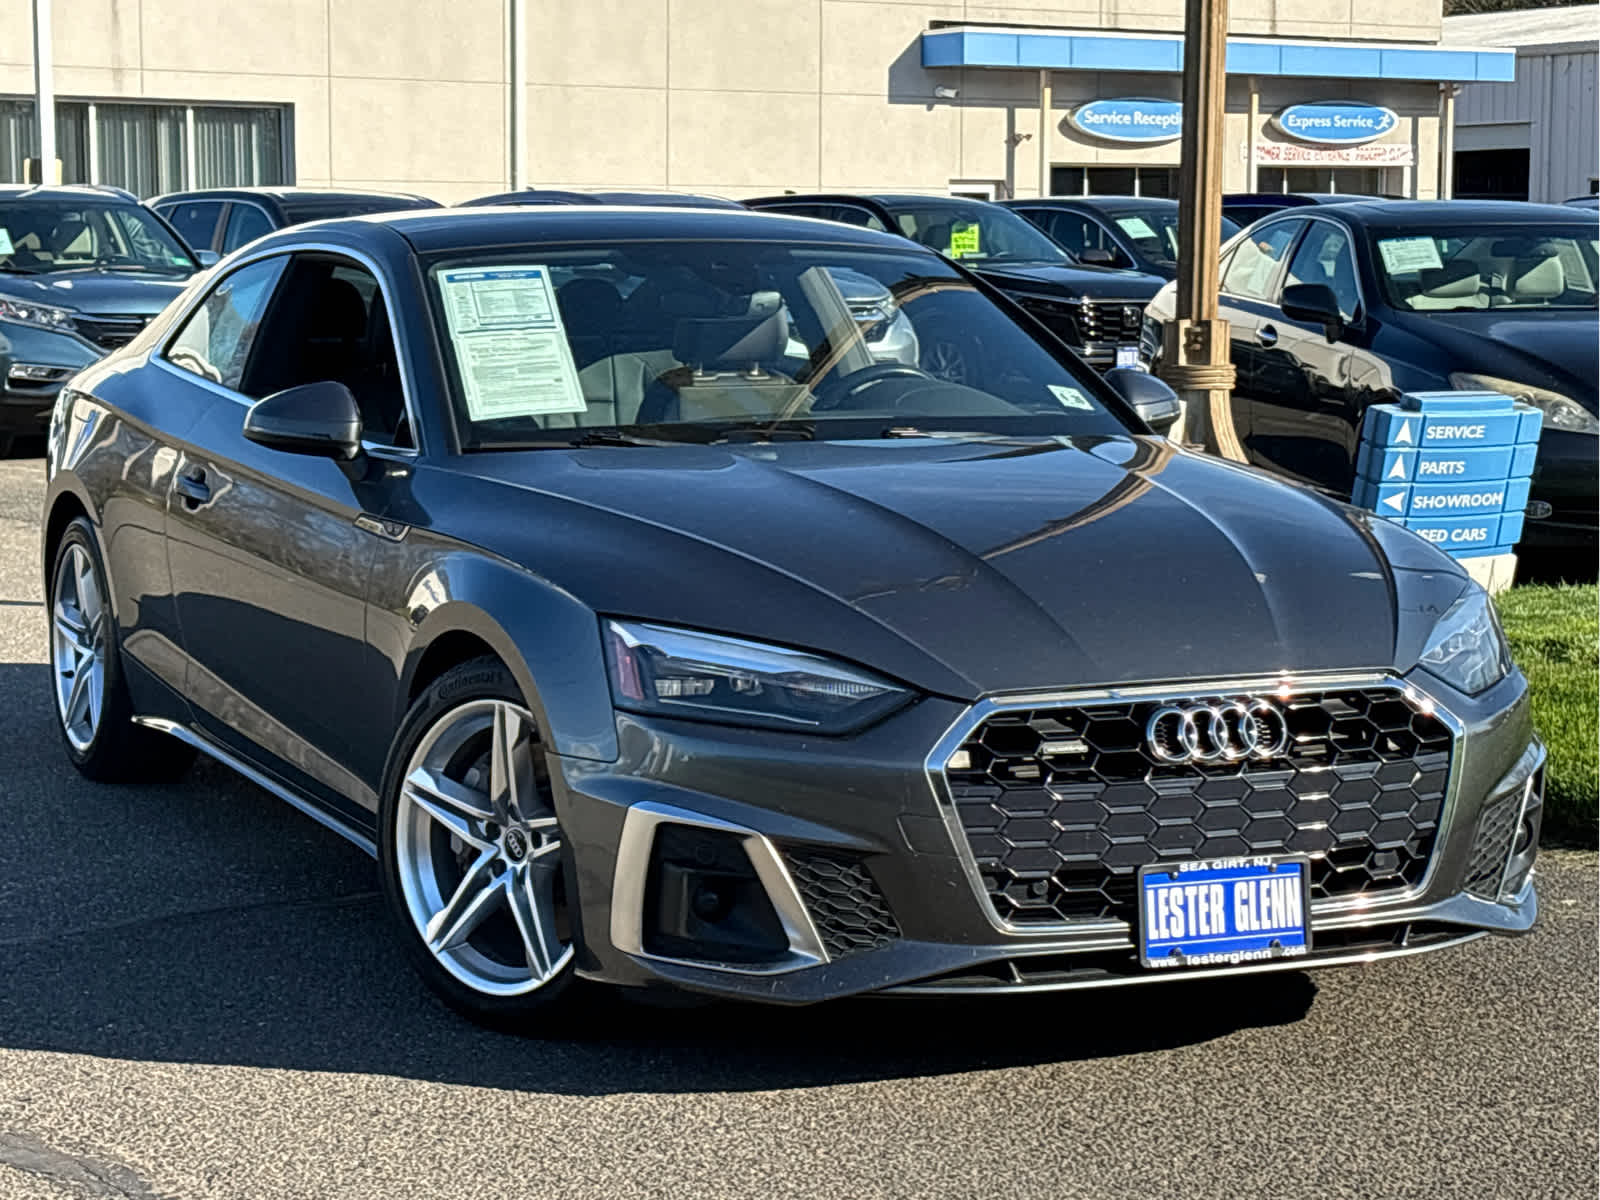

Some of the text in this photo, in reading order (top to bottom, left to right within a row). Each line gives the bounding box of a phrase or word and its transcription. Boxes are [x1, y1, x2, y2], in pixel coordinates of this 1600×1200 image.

[1084, 110, 1181, 128] Service Recepti
[1287, 115, 1374, 130] Express Service
[1426, 426, 1485, 439] SERVICE
[1420, 461, 1465, 474] PARTS
[1413, 493, 1503, 508] SHOWROOM
[1451, 528, 1487, 541] CARS
[1179, 861, 1209, 872] SEA
[1253, 856, 1272, 867] NJ
[1146, 876, 1303, 940] LESTER GLENN
[1149, 956, 1179, 968] www.
[1186, 948, 1272, 966] lesterglenn
